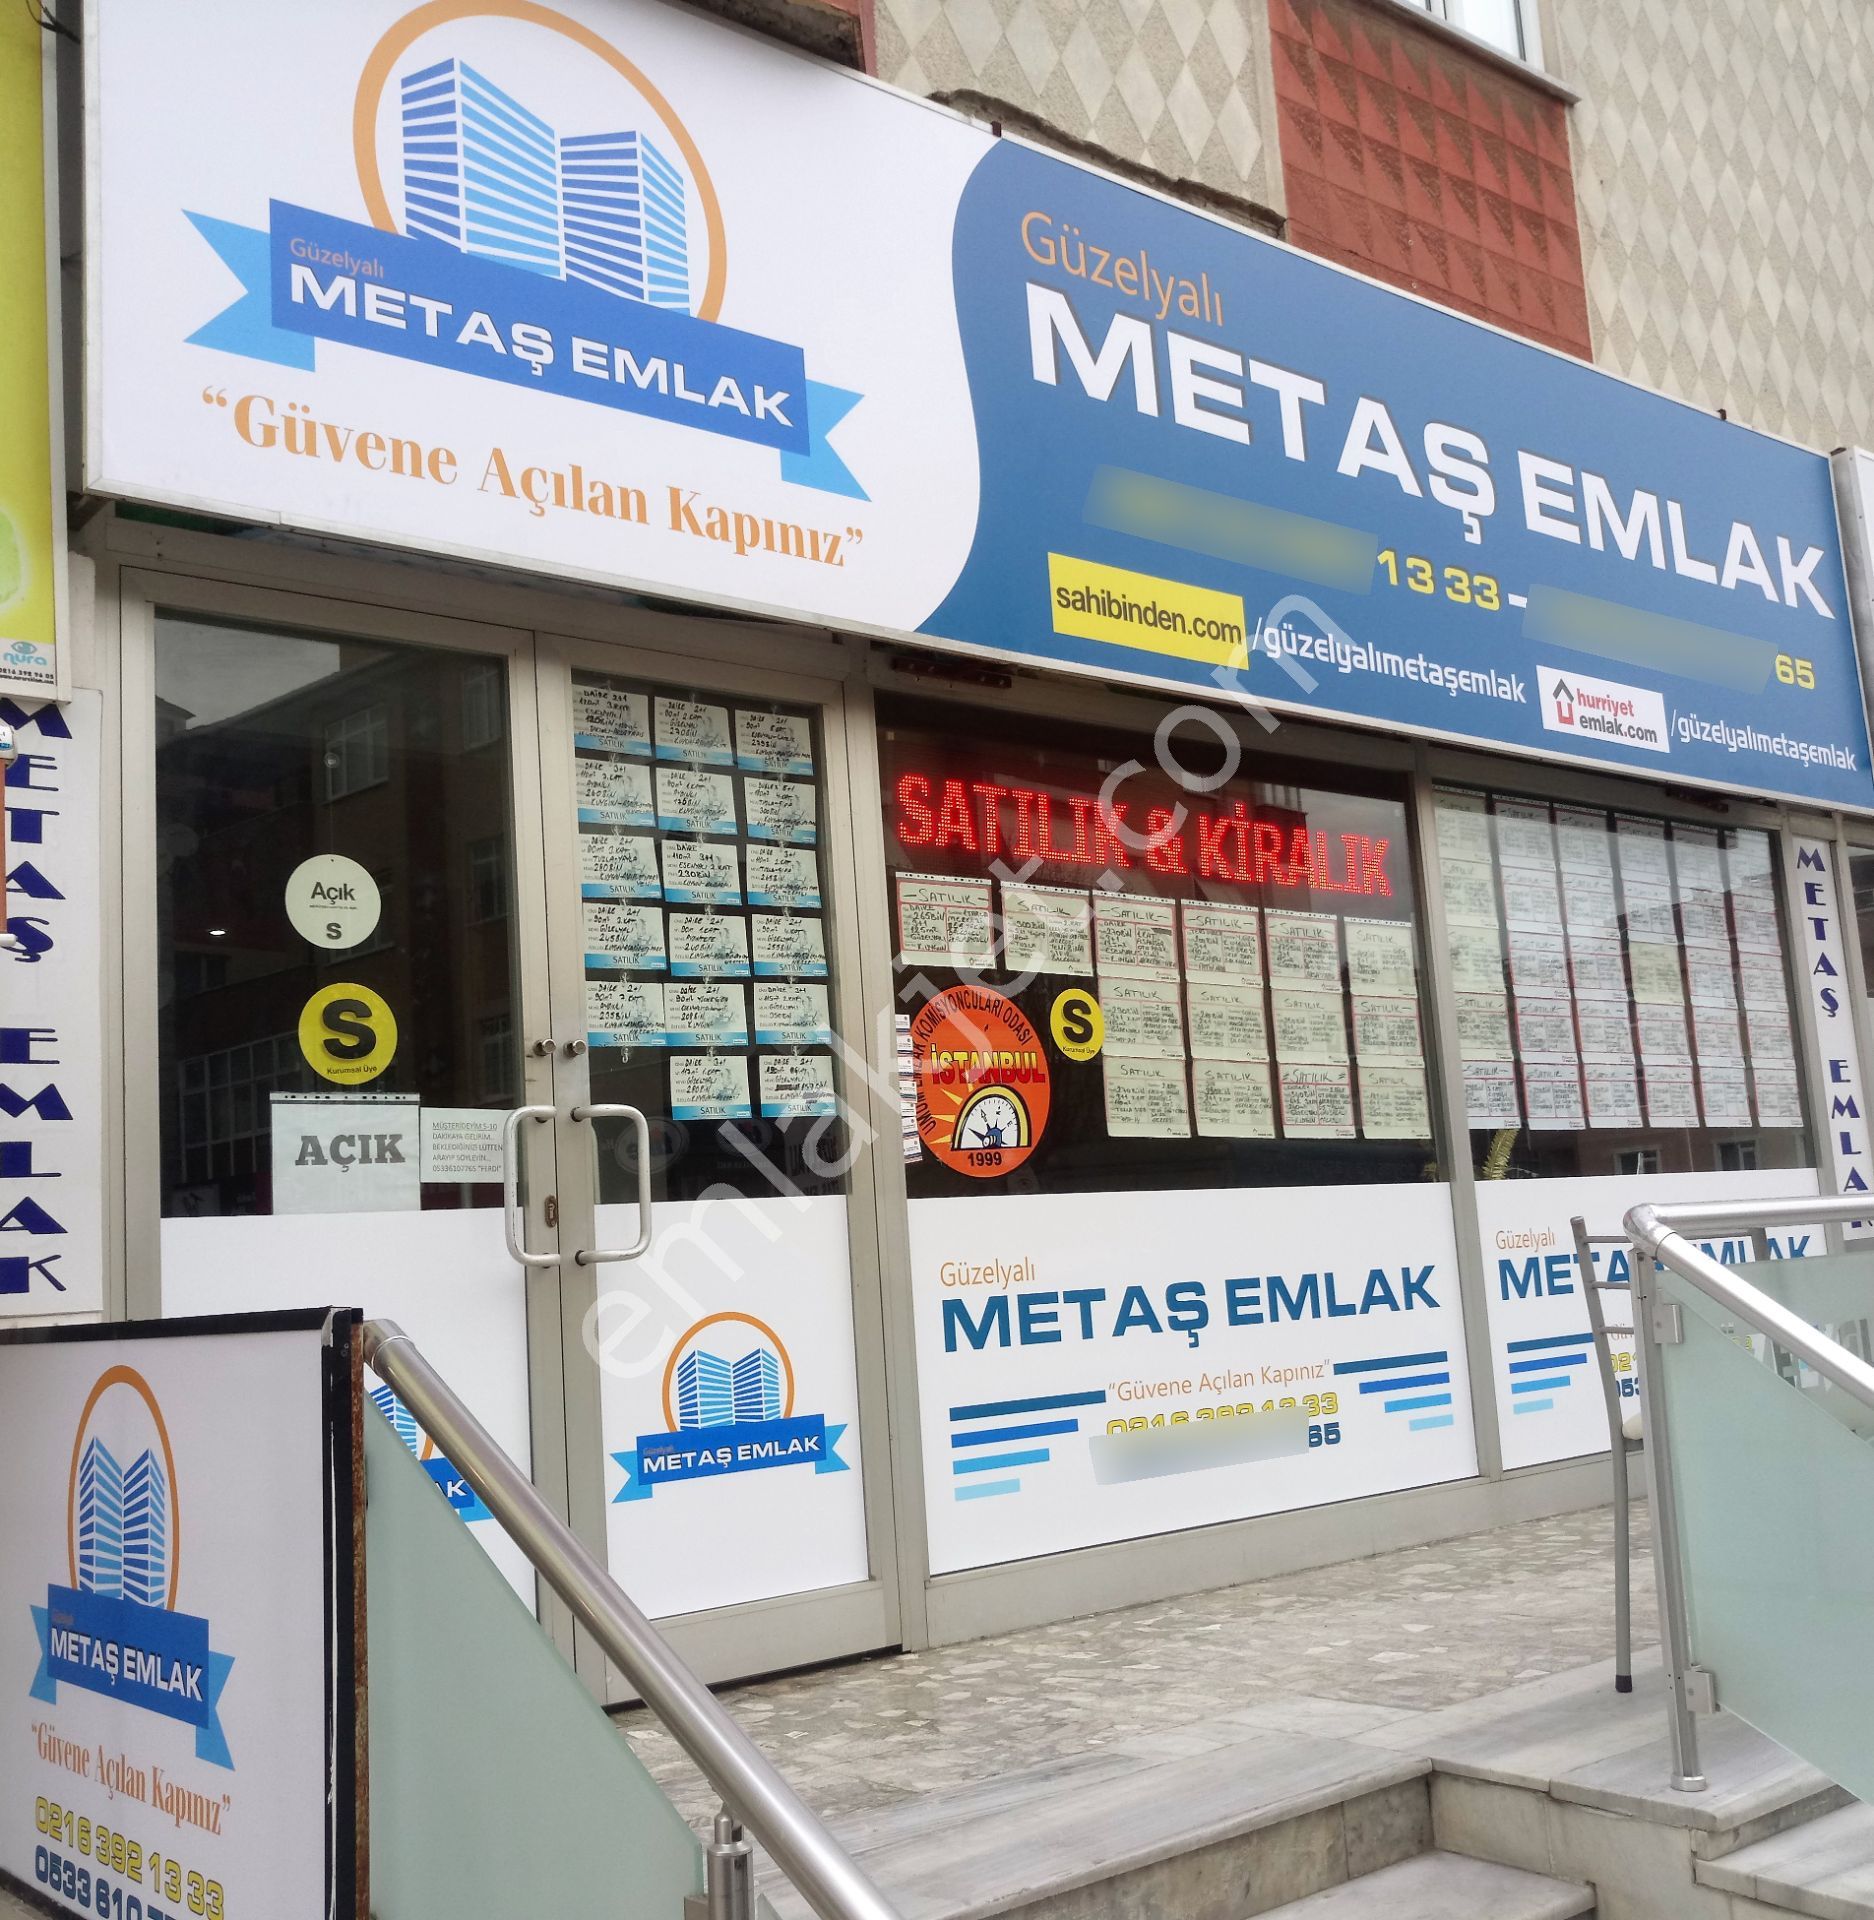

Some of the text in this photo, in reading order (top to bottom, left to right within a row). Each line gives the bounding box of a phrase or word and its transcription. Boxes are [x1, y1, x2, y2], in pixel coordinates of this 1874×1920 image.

[289, 237, 385, 280] Güzelyalı
[1020, 210, 1225, 327] Güzelyalı
[290, 264, 795, 429] METAŞ EMLAK
[1025, 281, 1497, 545] METAŞ
[1517, 450, 1834, 619] EMLAK
[477, 445, 649, 522] Açılan
[1056, 585, 1242, 645] sahibinden.com
[1377, 548, 1815, 690] 13 33 65
[1577, 687, 1635, 718] hurriyet
[1579, 712, 1659, 746] emlak.com
[898, 773, 1394, 897] SATILIK & KİRALIK
[310, 881, 356, 905] Açık
[918, 888, 976, 906] SATILIK
[326, 922, 342, 940] S
[1111, 906, 1159, 921] SATILIK
[1196, 915, 1242, 929] SATILIK
[1280, 922, 1325, 938] SATILIK
[1796, 846, 1840, 1018] METAŞ
[1113, 986, 1163, 1001] SATILIK
[1360, 1002, 1403, 1014] SATILIK
[322, 998, 377, 1060] S
[1002, 1007, 1034, 1046] ODASI
[1063, 999, 1093, 1044] S
[327, 1064, 362, 1075] Kurumsal
[930, 1043, 1046, 1085] İSTANBUL
[1120, 1064, 1166, 1078] SATILIK
[1204, 1070, 1257, 1082] SATILIK
[1292, 1069, 1333, 1085] SATILIK
[700, 1106, 726, 1115] SATILIK
[294, 1132, 406, 1173] AÇIK
[967, 1152, 1003, 1168] 1999
[1495, 1227, 1555, 1253] Güzelyalı
[939, 1258, 1036, 1289] Güzelyalı
[942, 1264, 1441, 1349] METAŞ EMLAK
[1199, 1369, 1255, 1395] Açılan
[642, 1447, 732, 1474] METAŞ
[737, 1435, 820, 1461] EMLAK
[50, 1627, 203, 1702] METAŞ EMLAK
[94, 1744, 147, 1803] Açılan
[35, 1796, 225, 1920] 0216 392 13 33
[35, 1844, 92, 1908] 0533
